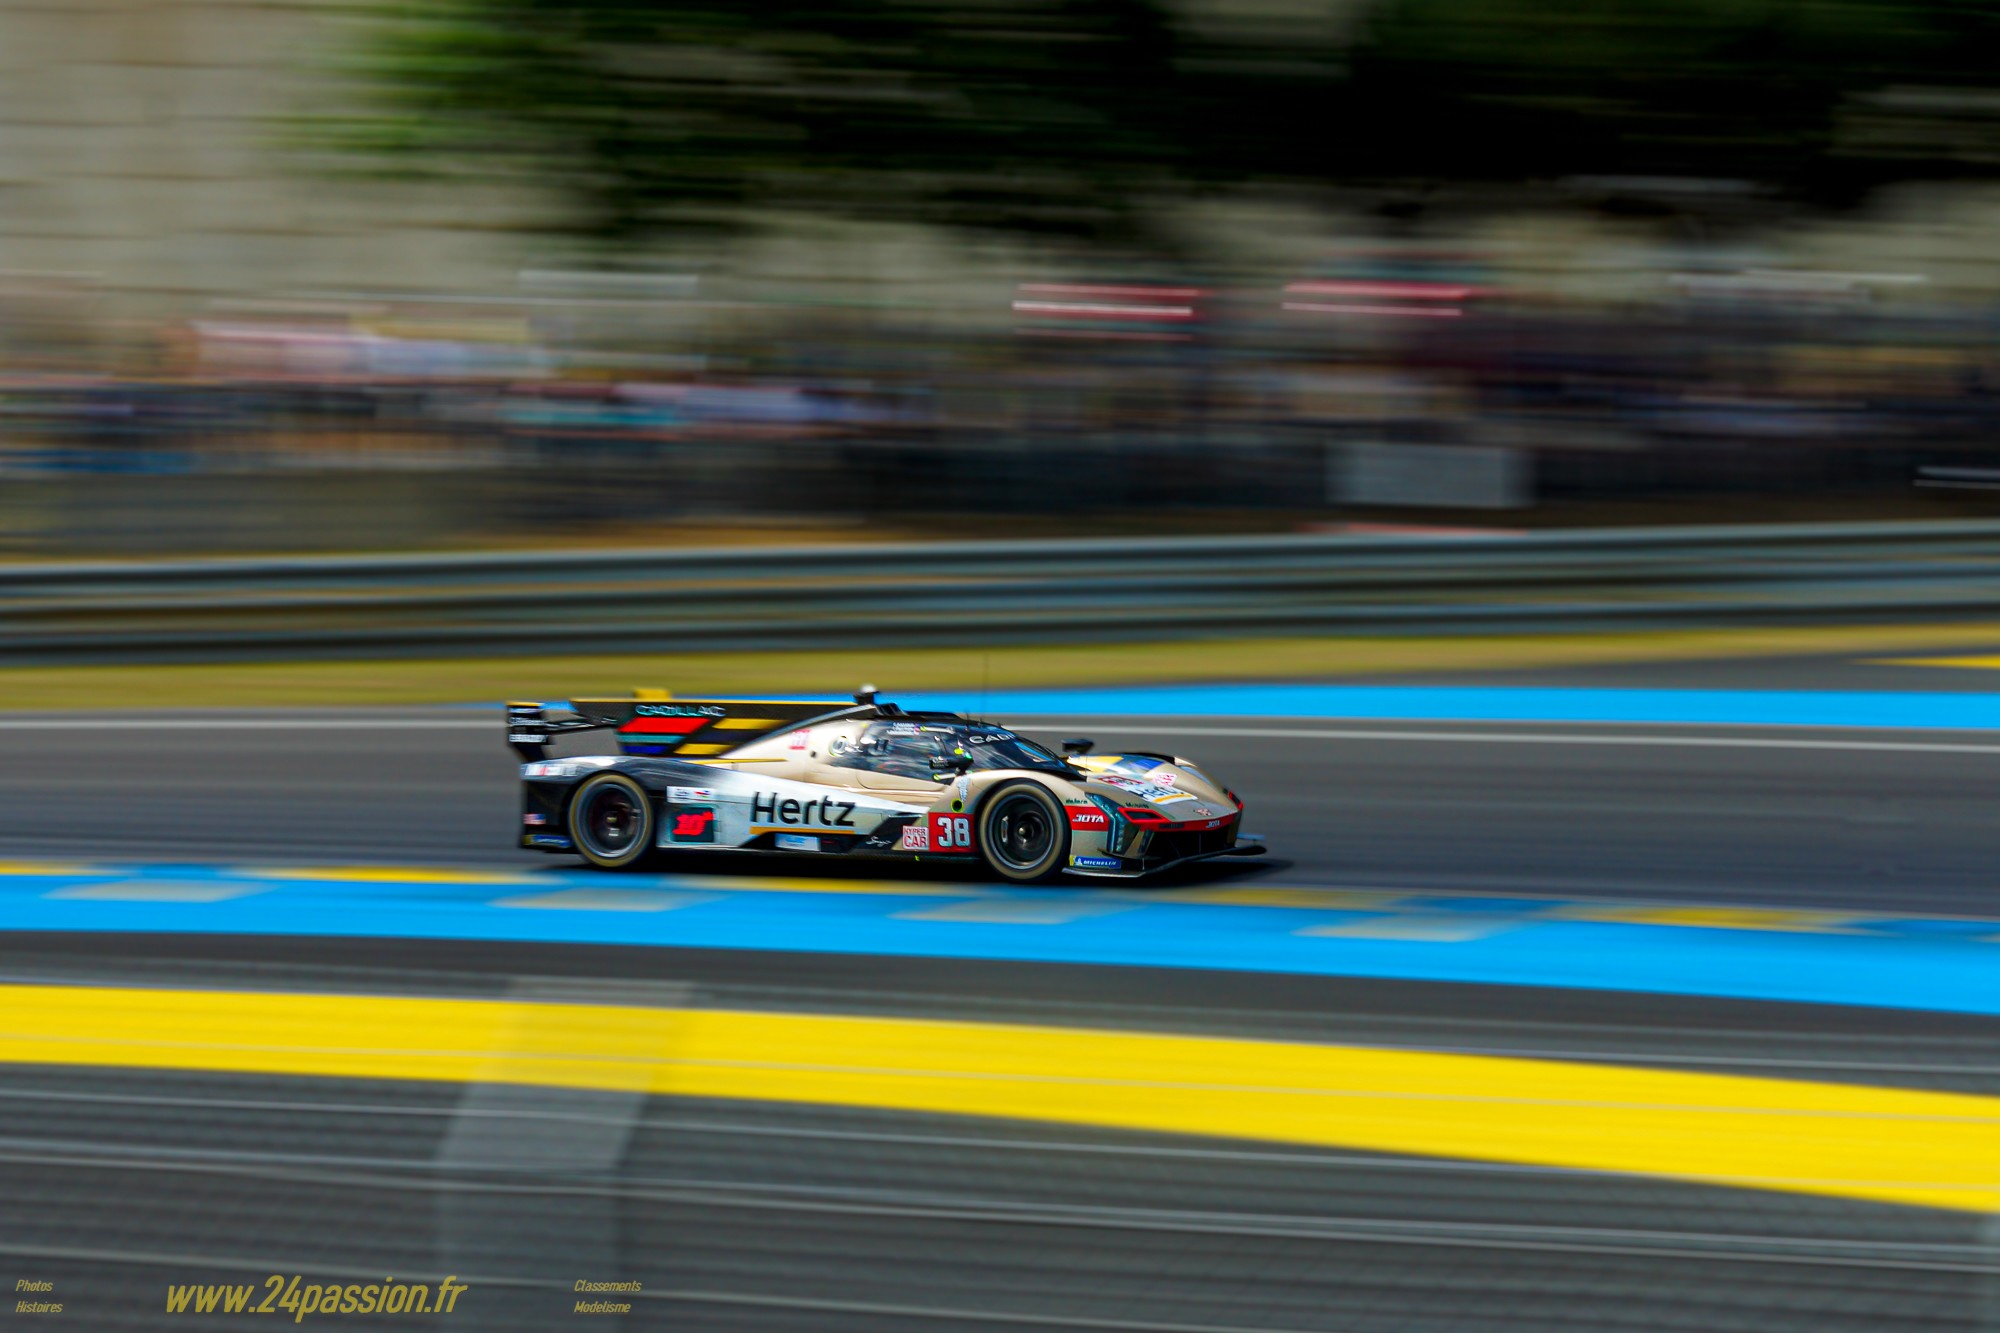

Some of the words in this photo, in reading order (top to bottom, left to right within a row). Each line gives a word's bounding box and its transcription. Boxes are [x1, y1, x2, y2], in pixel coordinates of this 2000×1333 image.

[750, 791, 855, 826] Hertz
[1072, 814, 1105, 823] JOTA
[904, 835, 927, 848] CAR
[937, 816, 971, 848] 38
